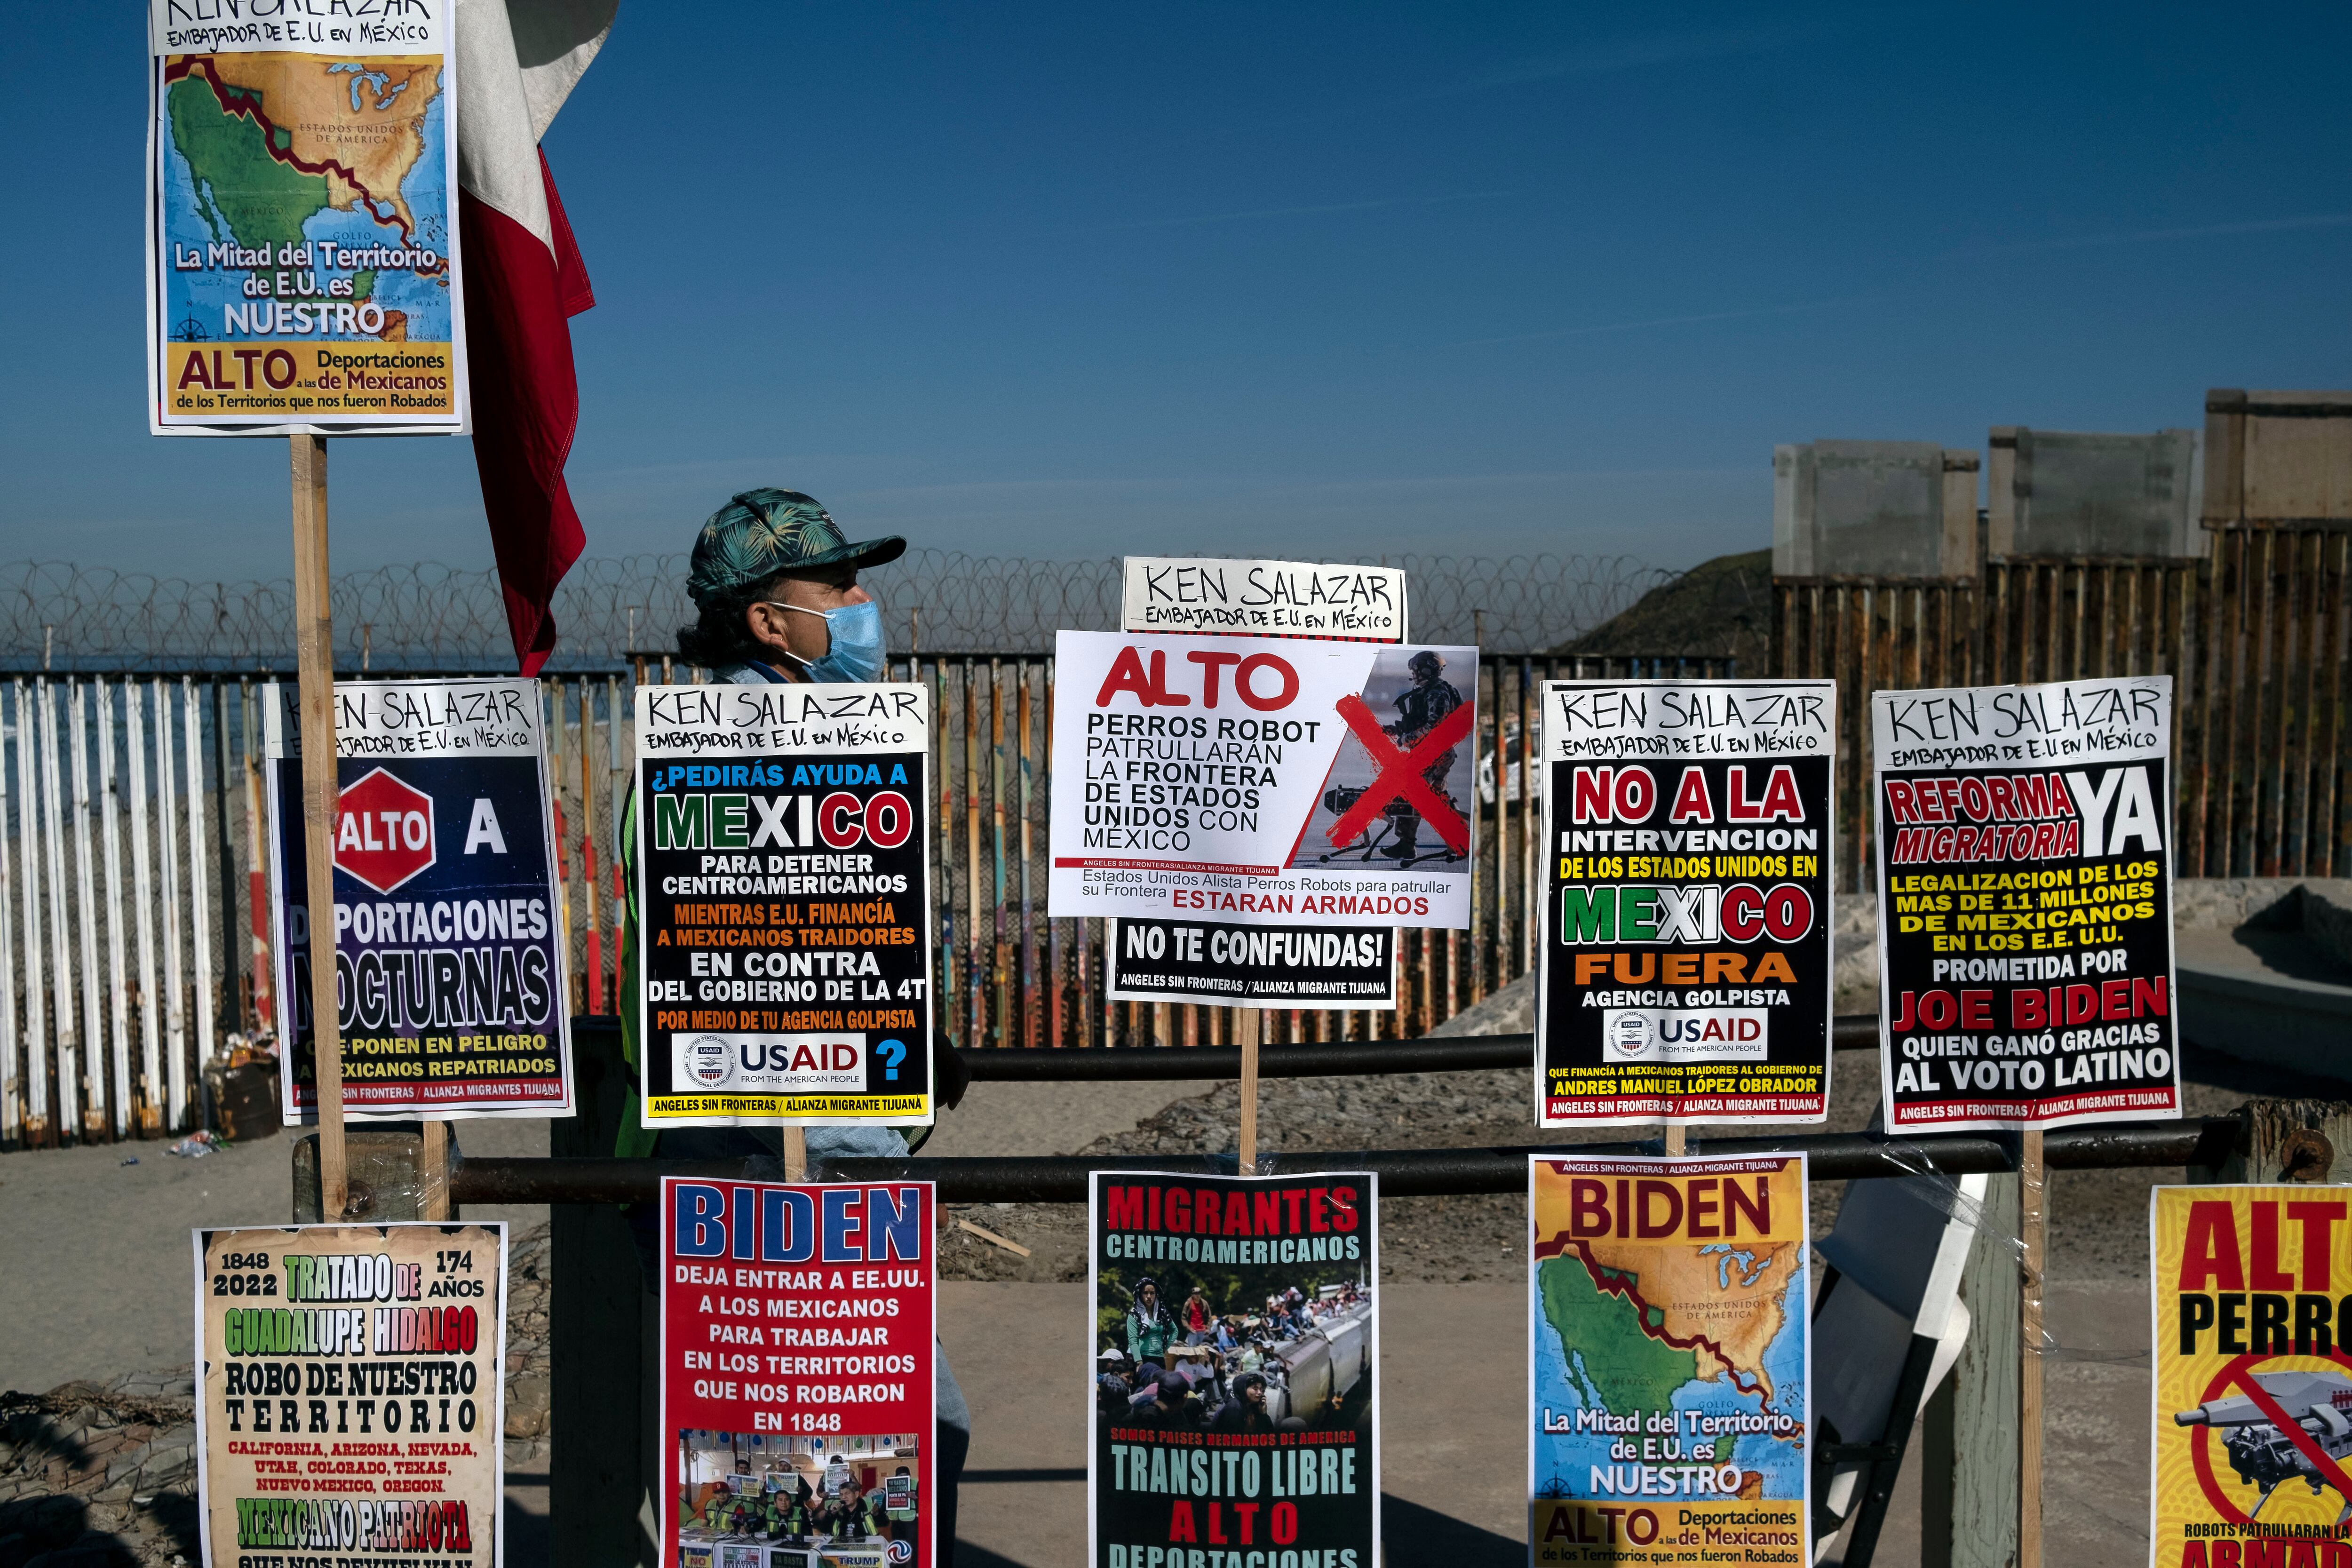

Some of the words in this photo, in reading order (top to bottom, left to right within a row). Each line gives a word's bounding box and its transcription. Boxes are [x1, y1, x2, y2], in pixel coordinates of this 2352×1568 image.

[300, 124, 352, 133] ESTADOS
[333, 231, 371, 240] GOLFO
[175, 242, 201, 269] La
[208, 242, 271, 268] Mitad
[279, 241, 312, 268] del
[319, 241, 437, 269] Territorio
[243, 273, 270, 296] de
[277, 272, 322, 296] E.U.
[329, 278, 353, 296] es
[225, 302, 384, 334] NUESTRO
[177, 349, 297, 391] ALTO
[304, 378, 316, 389] las
[318, 371, 341, 390] de
[347, 371, 447, 390] Mexicanos
[317, 350, 445, 373] Deportaciones
[176, 394, 193, 407] de
[197, 395, 213, 407] los
[217, 394, 285, 407] Territorios
[289, 396, 314, 411] que
[318, 397, 340, 407] nos
[343, 394, 387, 407] fueron
[390, 394, 446, 408] Robados
[1096, 646, 1299, 712] ALTO
[381, 690, 531, 729] SALAZAR
[649, 690, 722, 727] KEN
[731, 692, 924, 728] SALAZAR
[1088, 713, 1207, 739] PERROS
[1217, 718, 1321, 743] ROBOT
[645, 732, 743, 754] EMBAJADOR
[747, 732, 765, 748] DE
[812, 733, 832, 745] EN
[1087, 737, 1282, 765] PATRULLARÁN
[652, 759, 784, 792] ¿PEDIRÁS
[792, 764, 882, 787] AYUDA
[890, 764, 908, 785] A
[1573, 765, 1657, 824] NO
[1669, 766, 1714, 824] A
[1727, 765, 1806, 823] LA
[338, 811, 428, 852] ALTO
[464, 798, 508, 855] A
[654, 791, 913, 850] MEXICO
[1885, 772, 2075, 825] REFORMA
[2065, 766, 2162, 858] YA
[1561, 829, 1817, 852] INTERVENCION
[1891, 820, 2079, 865] MIGRATORIA
[1083, 868, 1143, 883] Estados
[1148, 871, 1198, 885] Unidos
[1202, 874, 1242, 889] Alista
[1248, 876, 1295, 891] Perros
[1301, 878, 1351, 891] Robots
[1356, 881, 1387, 894] para
[1391, 881, 1451, 895] patrullar
[1082, 885, 1099, 896] su
[1105, 883, 1167, 898] Frontera
[1173, 889, 1293, 913] ESTARAN
[1300, 895, 1429, 916] ARMADOS
[291, 899, 547, 945] DPORTACIONES
[1127, 925, 1166, 960] NO
[1173, 927, 1204, 962] TE
[1211, 929, 1383, 967] CONFUNDAS!
[1575, 952, 1798, 985] FUERA
[1582, 990, 1679, 1007] AGENCIA
[1685, 990, 1790, 1006] GOLPISTA
[1893, 989, 1994, 1032] JOE
[2012, 976, 2168, 1029] BIDEN
[687, 1039, 700, 1053] UNITED
[718, 1038, 732, 1053] AGENCY
[741, 1044, 858, 1072] USAID
[685, 1062, 713, 1087] INTERNATIONAL
[714, 1062, 734, 1087] DEVELOPMENT
[1549, 1068, 1569, 1077] QUE
[1571, 1065, 1616, 1077] FINANCÍA
[1618, 1067, 1624, 1076] A
[1627, 1067, 1684, 1076] MEXICANOS
[1685, 1066, 1738, 1075] TRAIDORES
[1756, 1065, 1806, 1074] GOBIERNO
[1809, 1065, 1822, 1074] DE
[342, 1088, 357, 1099] SIN
[360, 1087, 414, 1099] FRONTERAS
[424, 1085, 463, 1098] ALIANZA
[467, 1083, 521, 1096] MIGRANTES
[523, 1083, 561, 1095] TIJUANA
[654, 1099, 699, 1112] ANGELES
[701, 1099, 719, 1111] SIN
[722, 1099, 776, 1111] FRONTERAS
[778, 1100, 783, 1113] /
[786, 1099, 827, 1112] ALIANZA
[830, 1099, 880, 1111] MIGRANTE
[882, 1097, 922, 1110] TIJUANA
[1562, 1162, 1599, 1173] ANGELES
[1600, 1164, 1614, 1173] SIN
[1616, 1164, 1663, 1174] FRONTERAS
[1664, 1163, 1668, 1174] /
[1669, 1163, 1704, 1174] ALIANZA
[1705, 1162, 1744, 1172] MIGRANTE
[1745, 1161, 1778, 1170] TIJUANA
[1107, 1186, 1359, 1236] MIGRANTES
[1569, 1176, 1771, 1240] BIDEN
[675, 1184, 920, 1262] BIDEN
[1107, 1234, 1359, 1264] CENTROAMERICANOS
[214, 1274, 277, 1297] 2022
[428, 1275, 484, 1298] AÑOS
[222, 1252, 269, 1270] 1848
[283, 1254, 393, 1303] TRATADO
[396, 1264, 422, 1302] DE
[437, 1250, 473, 1273] 174
[225, 1308, 366, 1357] GUADALUPE
[373, 1305, 478, 1355] HIDALGO
[754, 1411, 782, 1430] EN
[790, 1413, 841, 1431] 1848
[228, 1441, 328, 1458] CALIFORNIA,
[330, 1442, 405, 1458] ARIZONA,
[408, 1442, 477, 1457] NEVADA,
[1111, 1428, 1155, 1442] SOMOS
[1159, 1430, 1203, 1445] PAISES
[1207, 1433, 1275, 1447] HERMANOS
[1280, 1433, 1295, 1445] DE
[1299, 1431, 1356, 1444] AMERICA
[1111, 1445, 1260, 1497] TRANSITO
[1271, 1448, 1356, 1496] LIBRE
[2185, 1523, 2236, 1537] ROBOTS
[2239, 1523, 2330, 1539] PATRULLARAN
[2334, 1524, 2350, 1539] LA
[691, 1557, 705, 1566] NO
